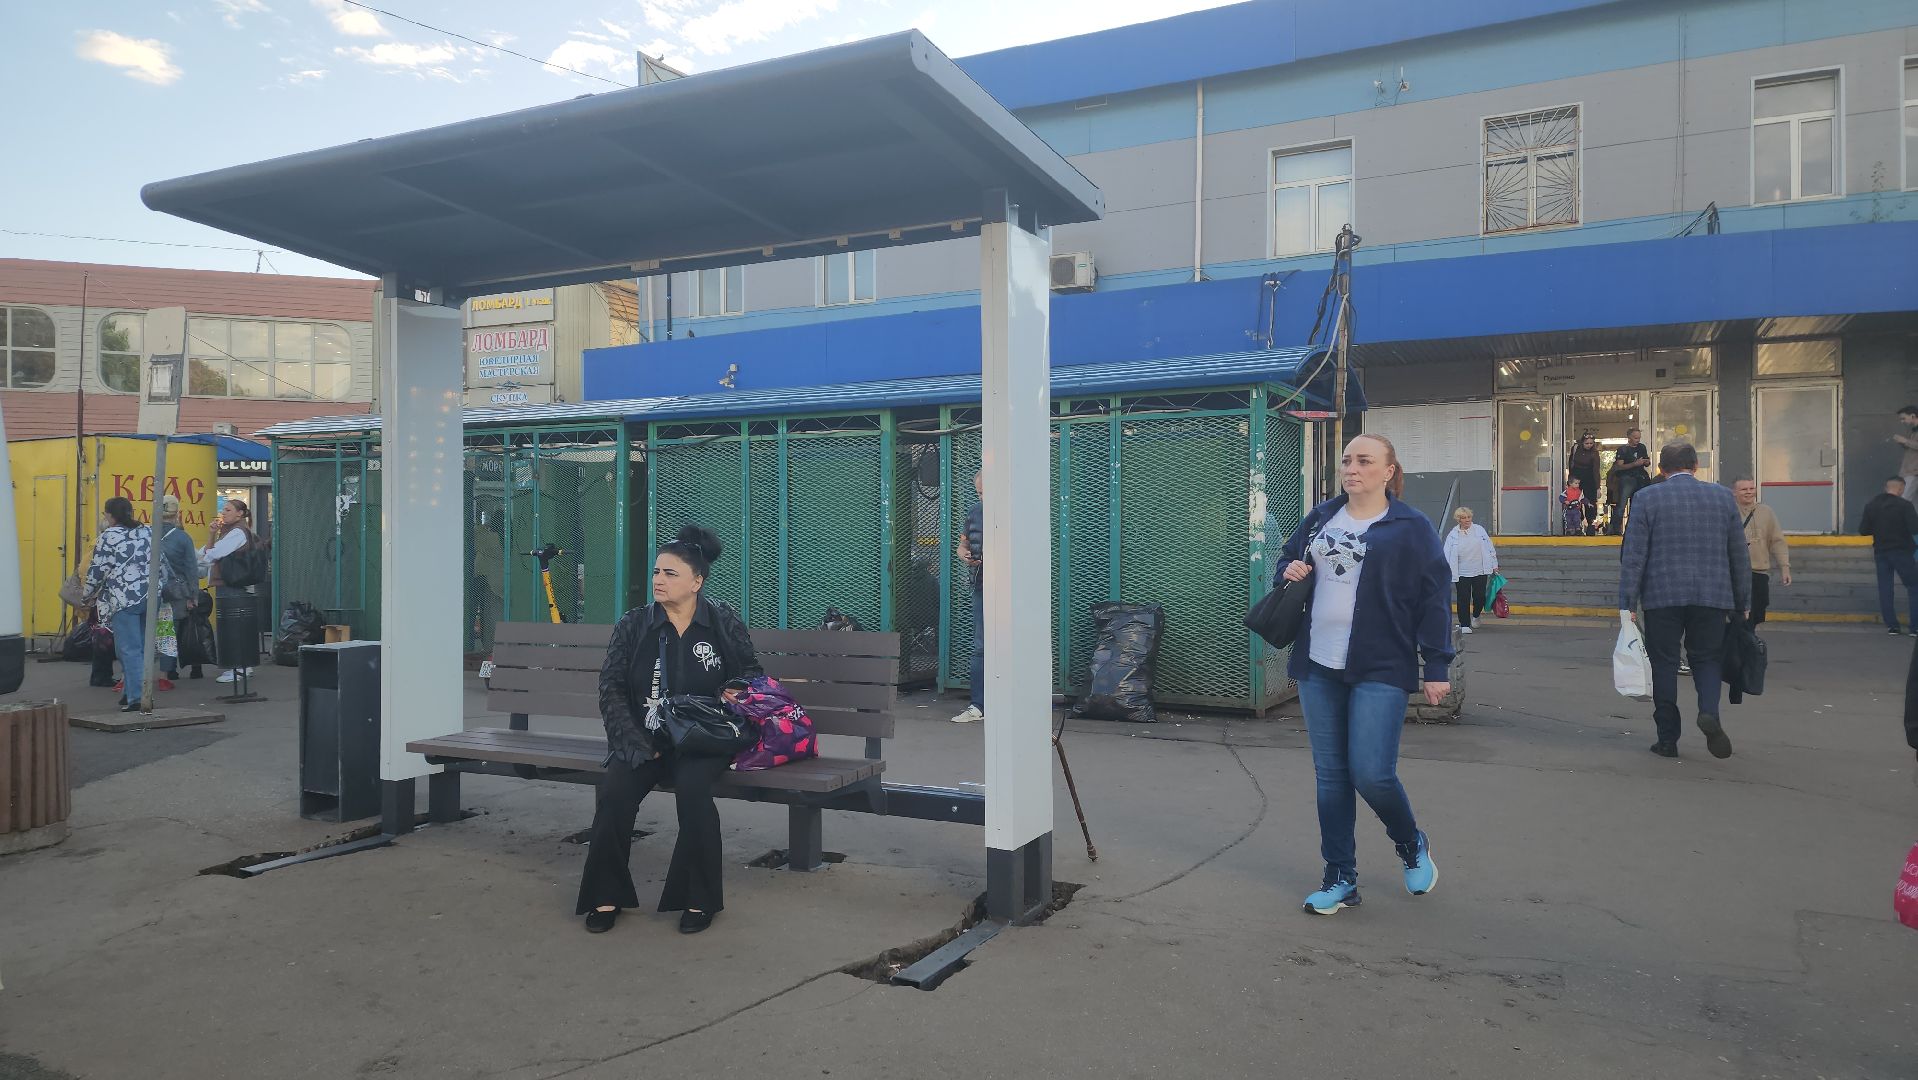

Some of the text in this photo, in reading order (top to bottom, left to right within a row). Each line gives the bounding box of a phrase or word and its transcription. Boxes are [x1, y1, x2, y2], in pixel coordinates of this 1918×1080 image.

[472, 296, 523, 310] ЛОМБАРД
[471, 328, 549, 352] ЛОМБАРД
[479, 353, 538, 366] ЮВЕЛИРНАЯ
[479, 366, 539, 378] МАСТЕРСКАЯ
[490, 392, 528, 404] СКУПКА
[112, 474, 204, 505] КВАС
